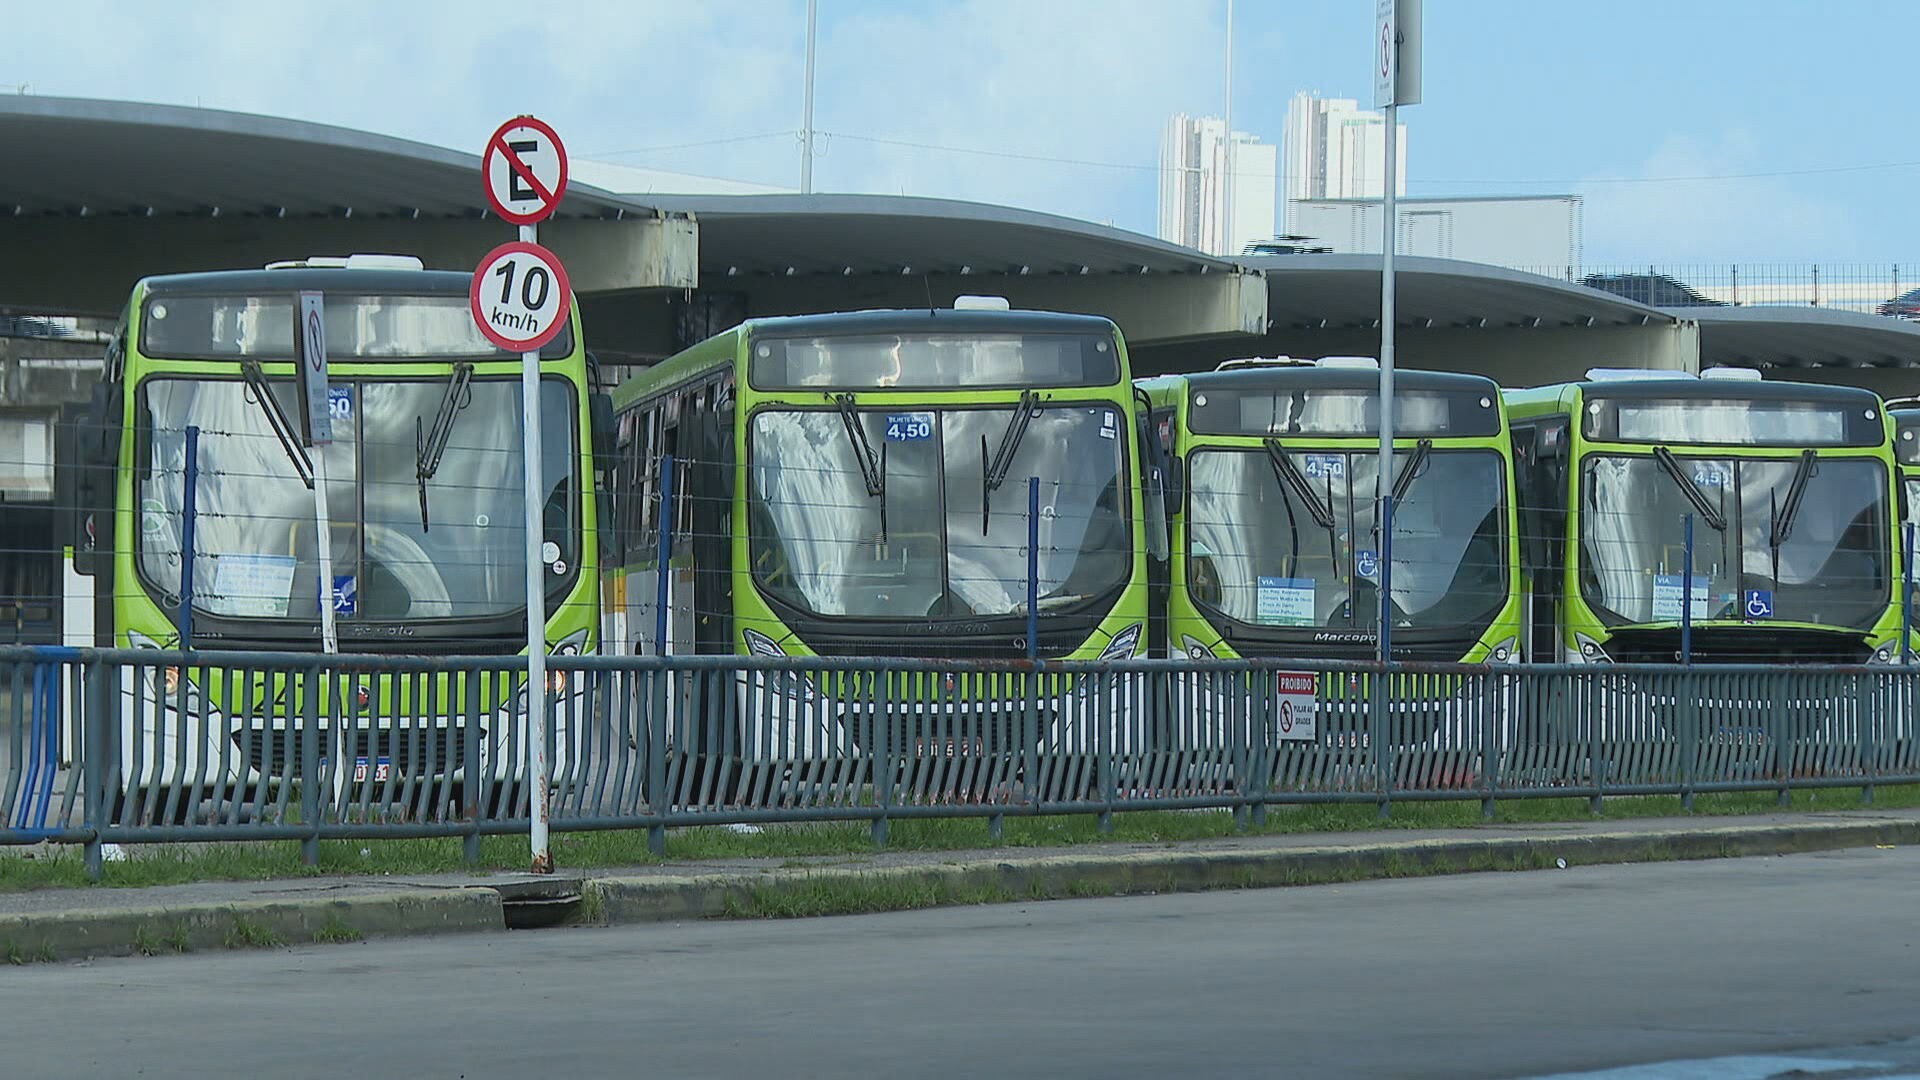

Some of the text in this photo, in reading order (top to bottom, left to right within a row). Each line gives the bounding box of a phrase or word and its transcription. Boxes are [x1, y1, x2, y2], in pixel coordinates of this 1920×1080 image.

[509, 141, 538, 201] E
[495, 260, 550, 311] 10
[491, 306, 538, 333] km/h
[887, 423, 930, 441] 4,50
[1306, 462, 1342, 477] 4,50
[1314, 632, 1377, 643] Marcopo
[1280, 677, 1312, 691] PROIBIDO
